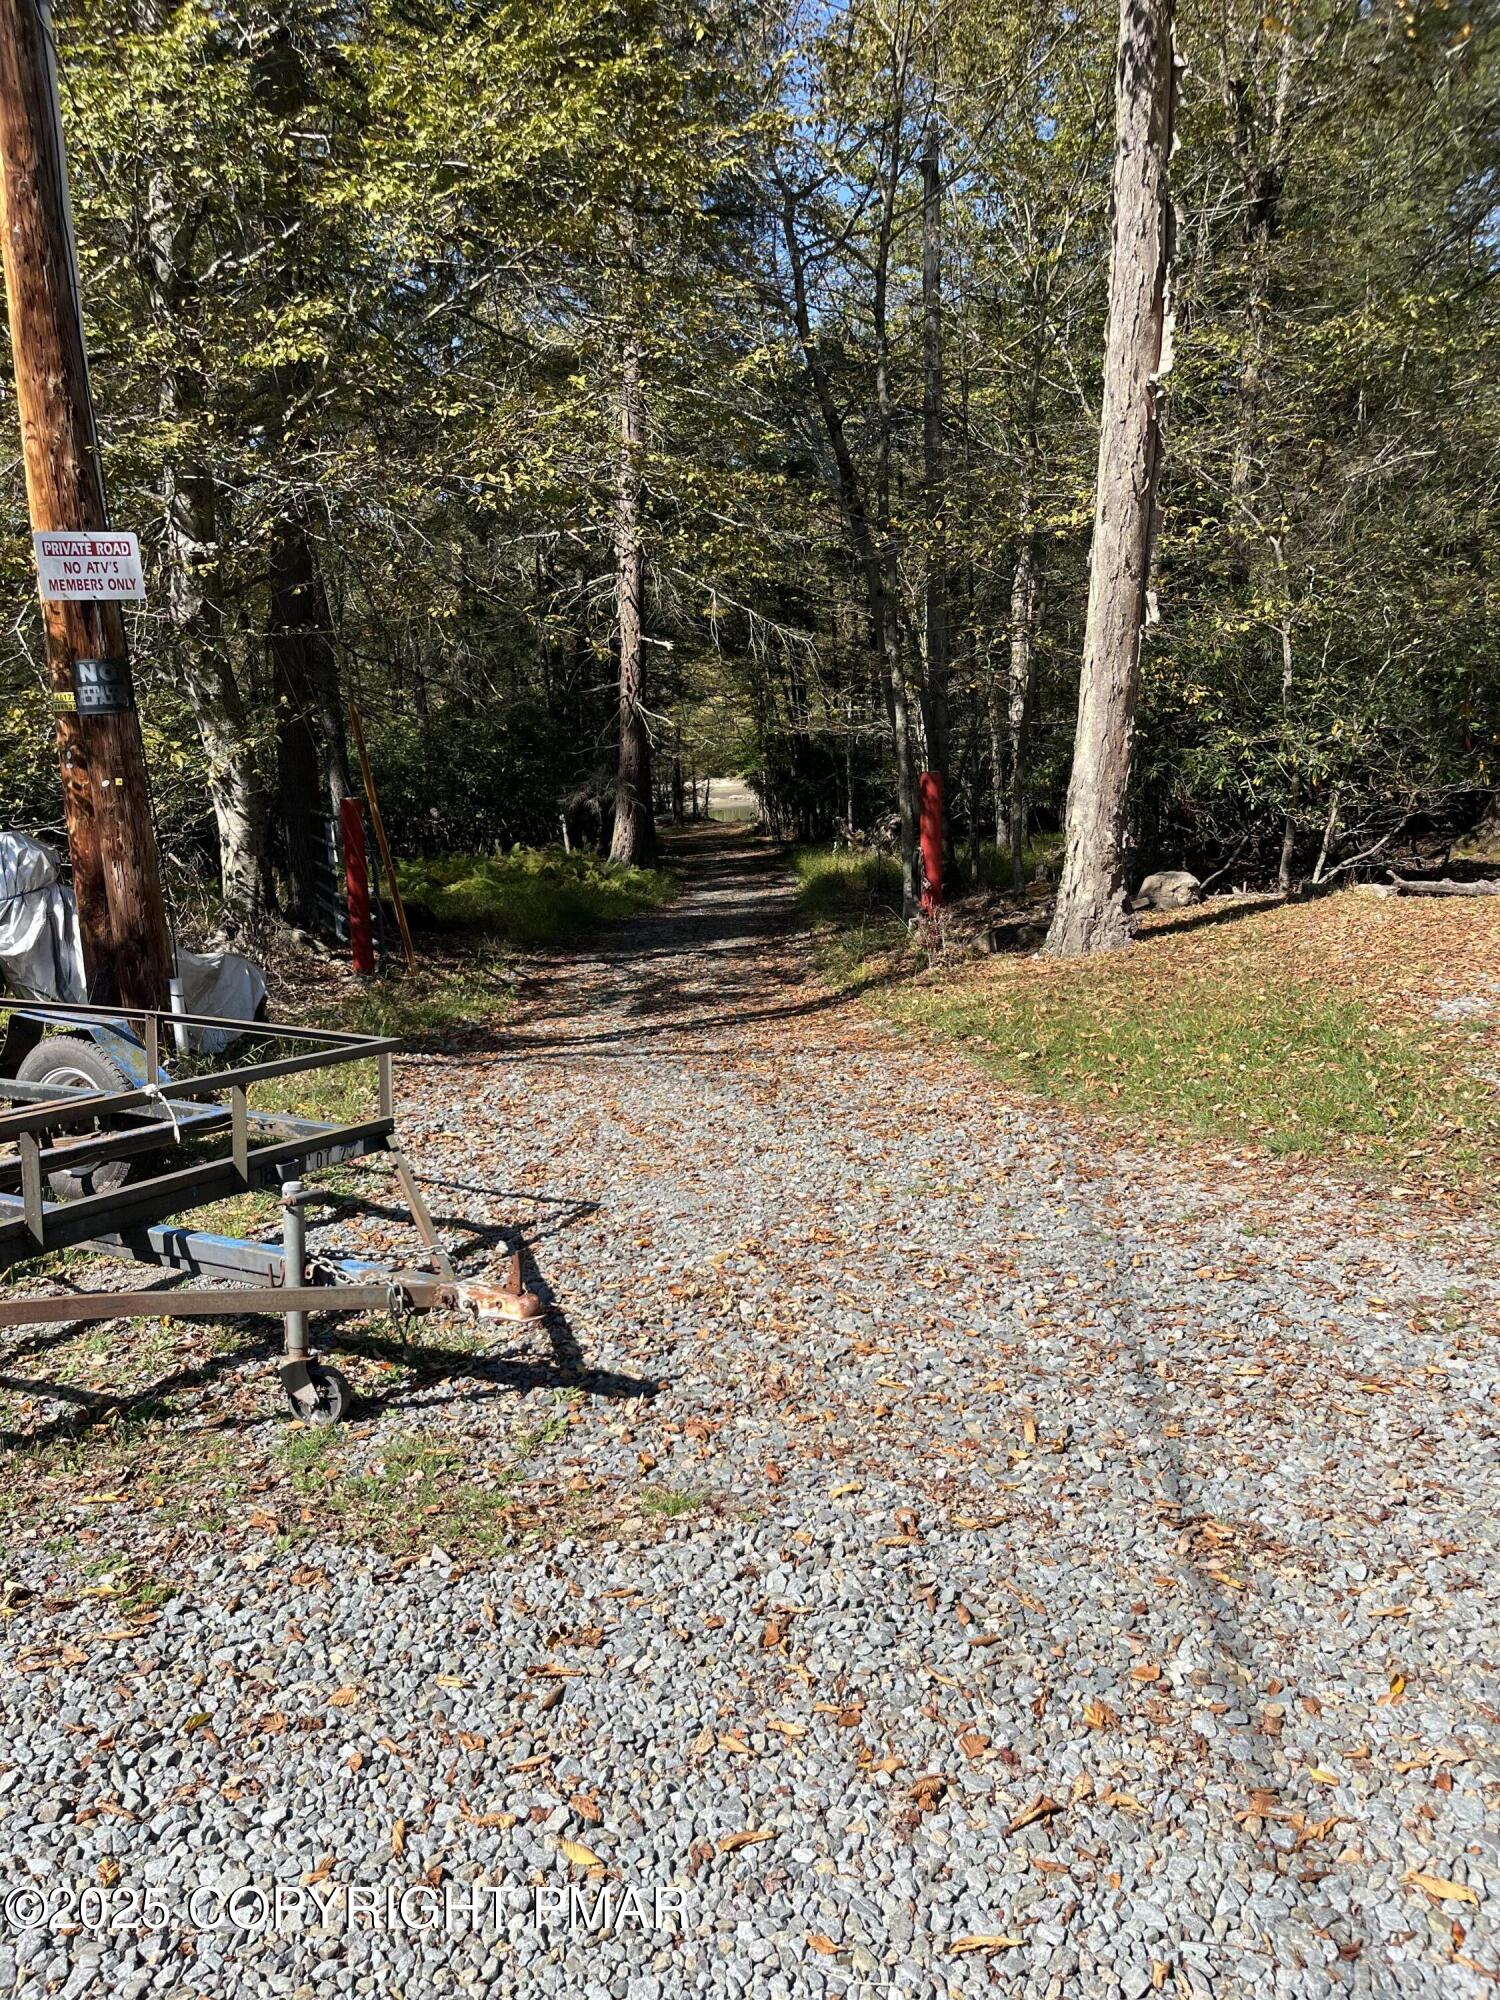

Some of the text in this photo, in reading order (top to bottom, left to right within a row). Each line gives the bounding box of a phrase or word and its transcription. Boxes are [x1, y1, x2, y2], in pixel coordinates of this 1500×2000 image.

[44, 541, 130, 556] PRIVATE ROAD
[64, 562, 119, 574] NO ATV'S
[49, 579, 136, 591] MEMBERS ONLY
[79, 663, 116, 682] NO
